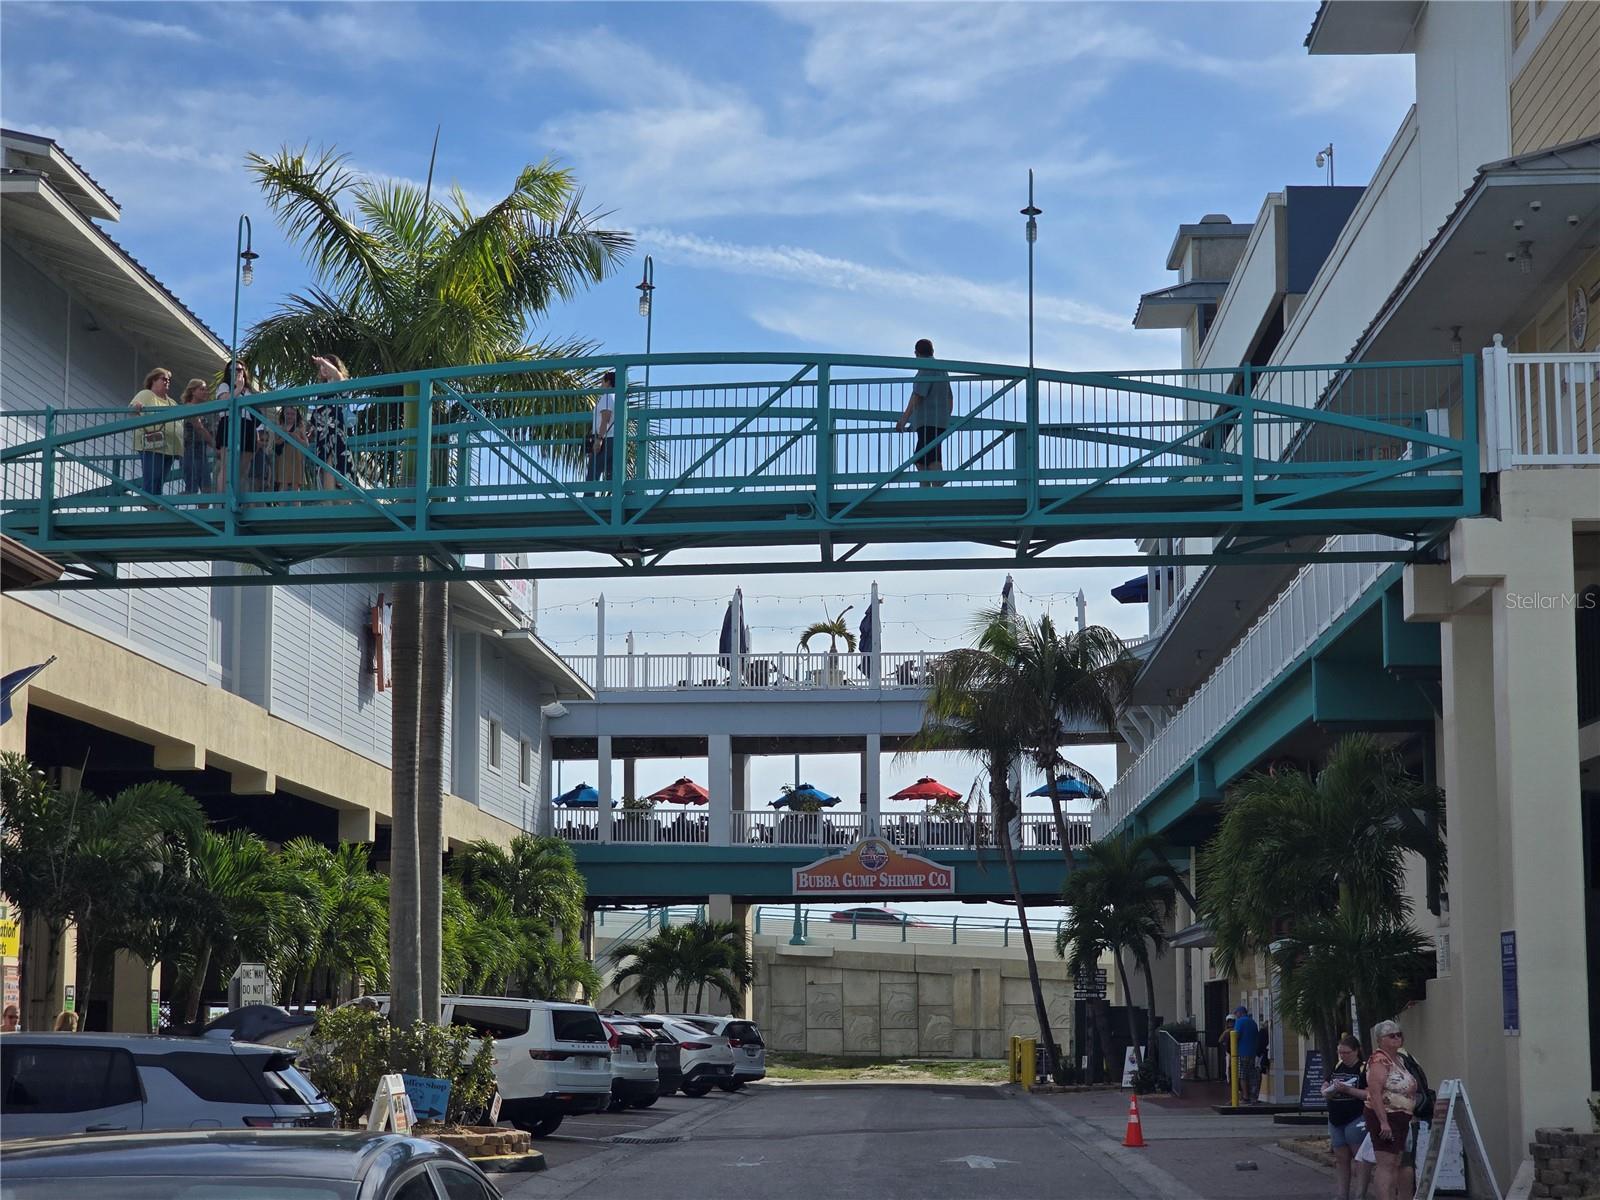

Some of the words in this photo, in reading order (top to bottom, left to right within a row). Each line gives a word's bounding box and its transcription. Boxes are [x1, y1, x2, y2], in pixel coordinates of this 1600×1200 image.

[799, 872, 841, 888] BUBBA
[842, 872, 877, 888] GUMP
[879, 872, 926, 888] SHRIMP
[928, 871, 949, 887] CO.
[243, 985, 250, 994] DO
[253, 985, 264, 994] NOT
[425, 1081, 447, 1093] Shop
